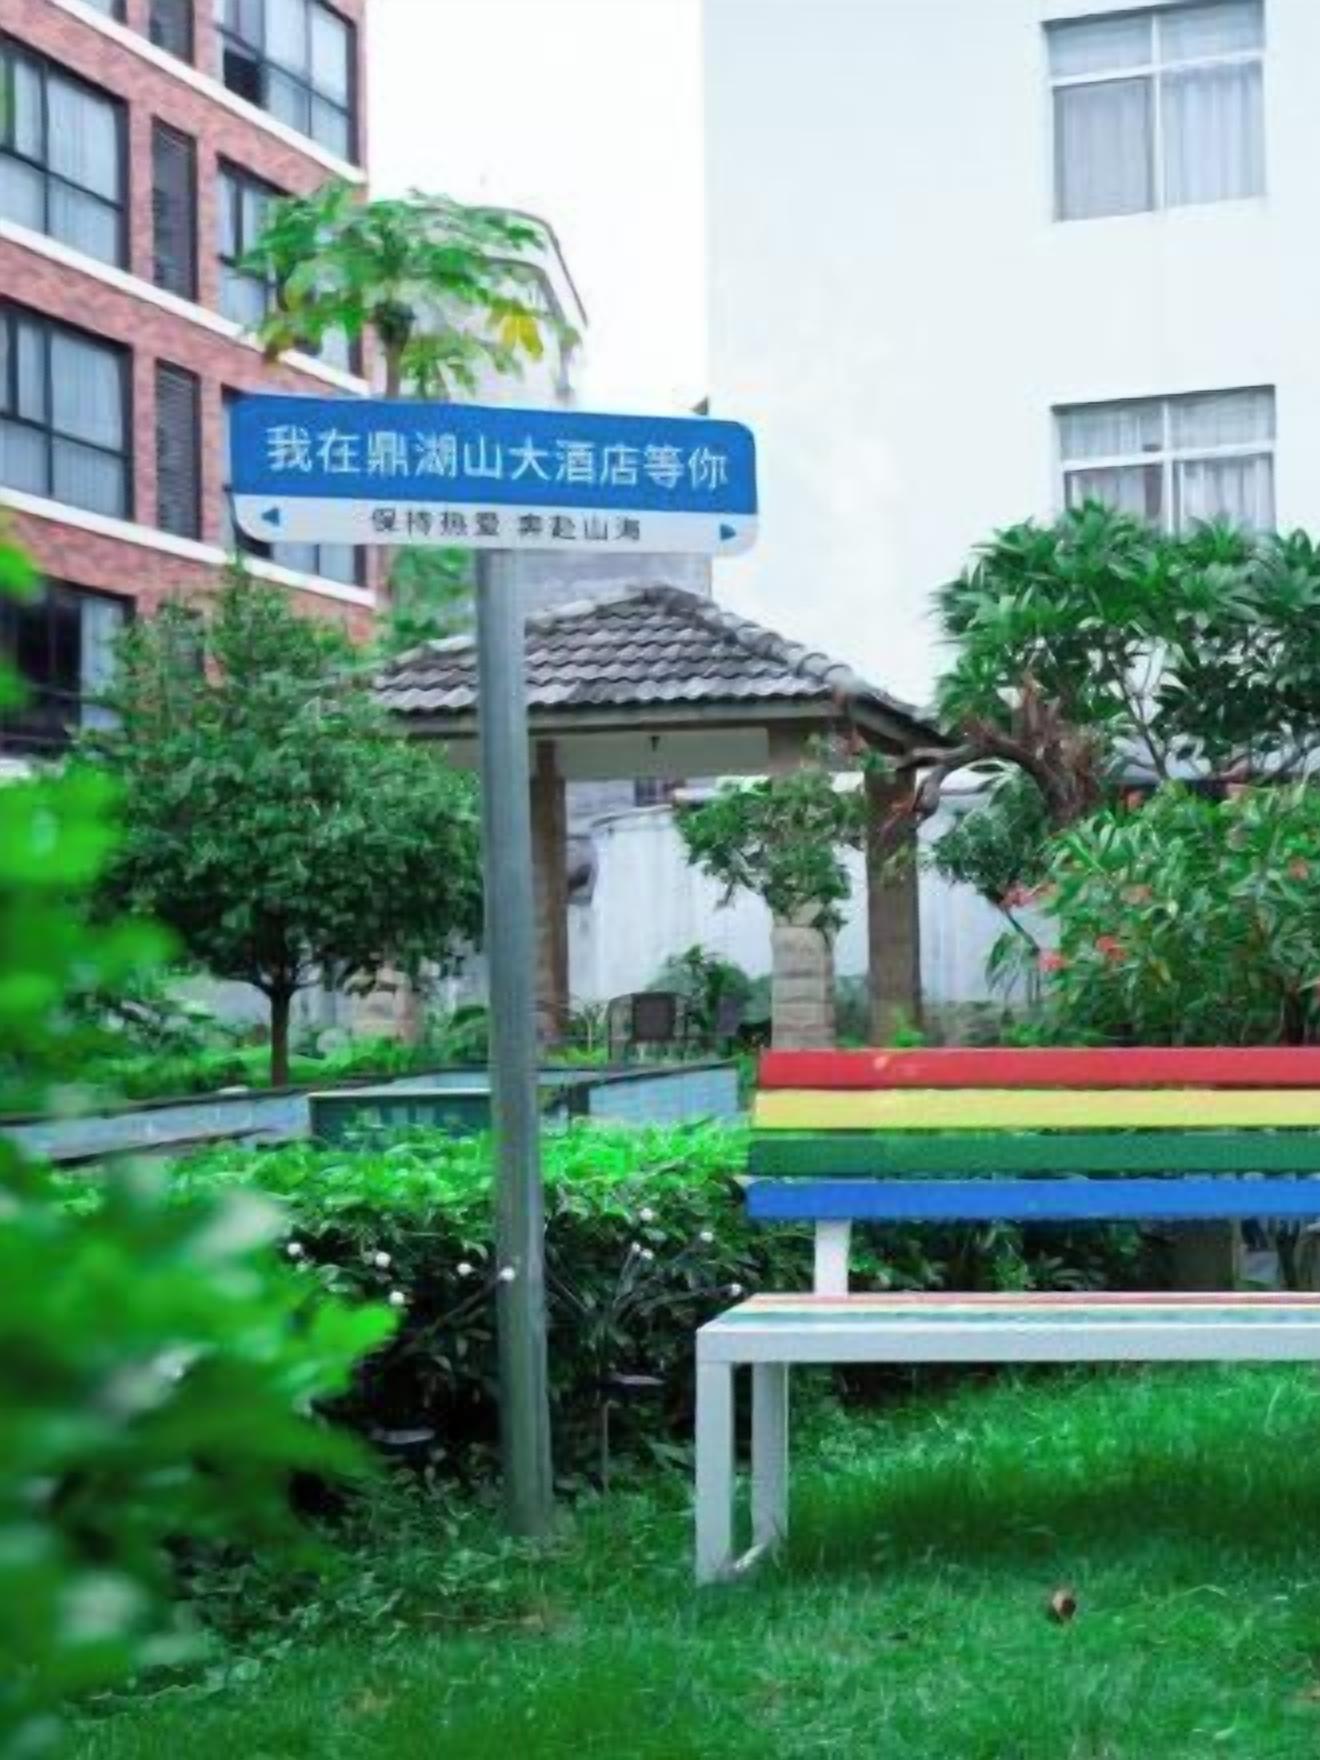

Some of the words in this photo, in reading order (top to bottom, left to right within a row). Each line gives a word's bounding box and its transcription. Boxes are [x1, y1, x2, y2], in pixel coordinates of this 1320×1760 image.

[266, 424, 728, 490] 我在鼎湖山大酒店等你
